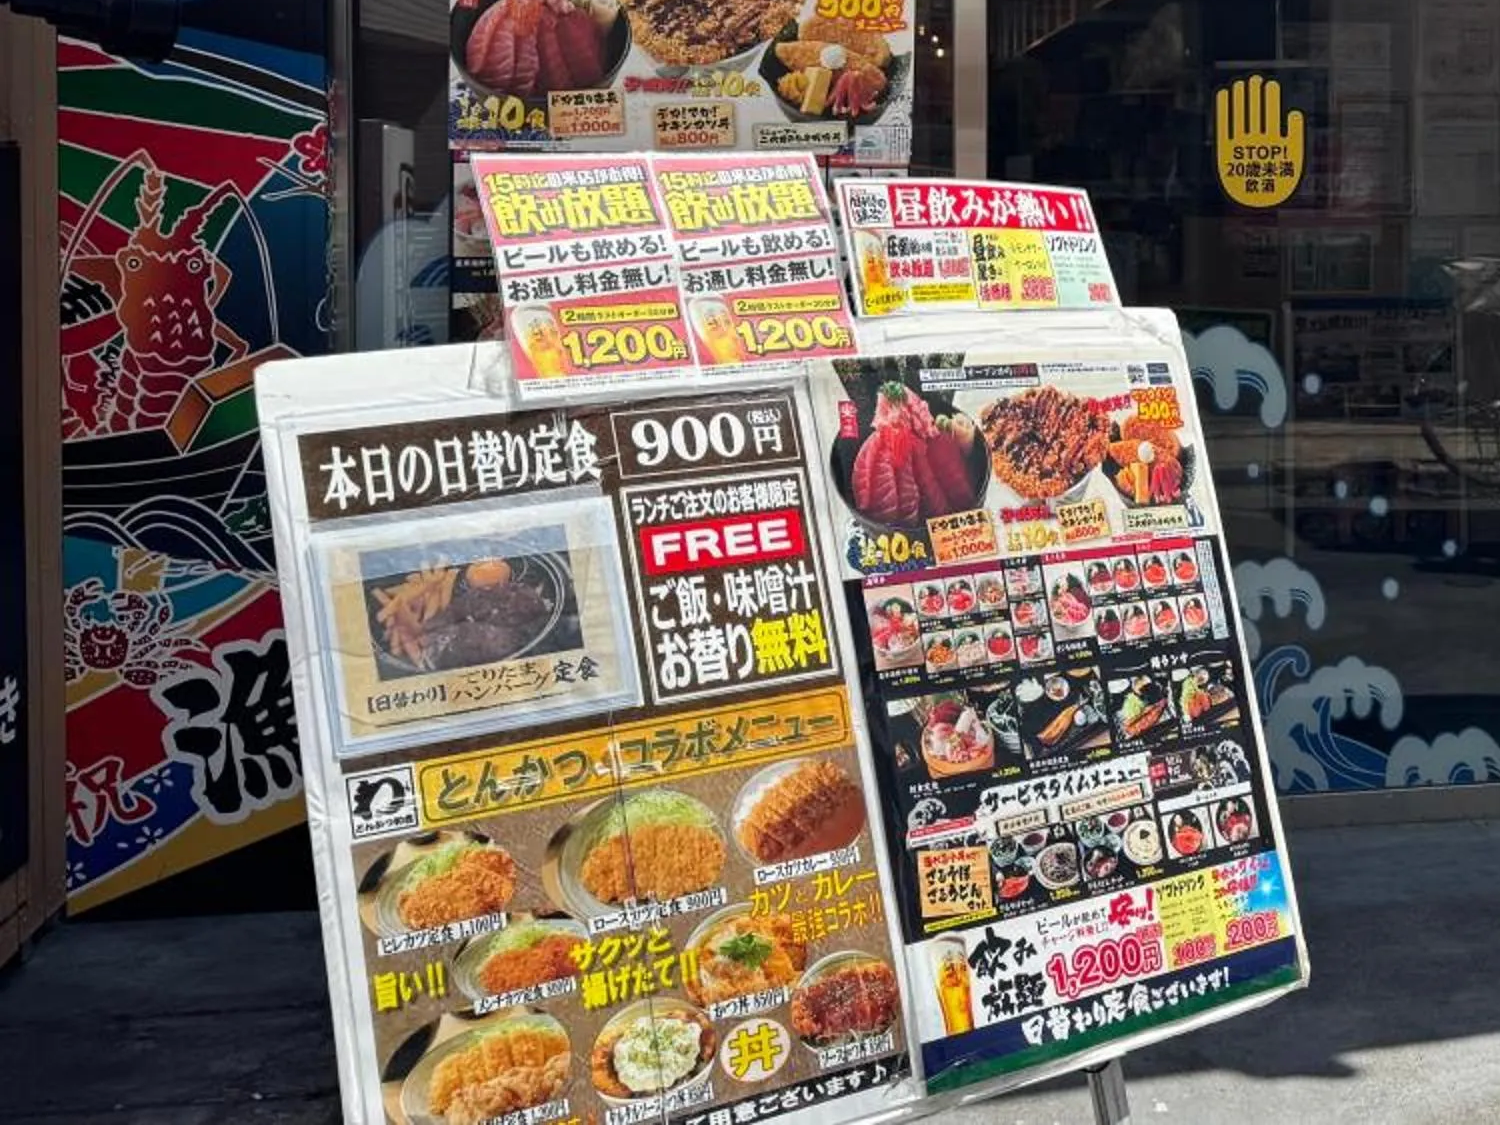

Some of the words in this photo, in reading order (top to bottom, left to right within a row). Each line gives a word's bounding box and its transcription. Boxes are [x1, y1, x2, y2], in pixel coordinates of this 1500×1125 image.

[1227, 161, 1294, 178] 20歳未満
[1233, 146, 1289, 160] STOP!
[661, 181, 822, 232] 飲み放題
[895, 186, 1092, 230] 昼飲みが熱い!!
[1245, 178, 1276, 193] 飲酒
[489, 181, 658, 237] 飲み放題
[503, 236, 666, 269] ビールも飲める!
[678, 230, 831, 264] ビールも飲める!
[507, 265, 672, 303] お通し料金無し!
[683, 258, 835, 295] お通し料金無し!
[562, 324, 689, 368] 1,200円
[735, 315, 850, 356] 1,200円
[321, 420, 600, 509] 本日の日替り定食
[631, 481, 800, 523] ランチご注文のお客様限定
[651, 518, 793, 567] FREE
[650, 560, 815, 629] ご飯・味噌汁
[552, 656, 600, 684] 定食
[657, 609, 828, 689] お替り無料
[438, 750, 590, 811] とんかつ
[619, 712, 835, 767] コラボメニュー
[983, 768, 1142, 813] サービスタイムメニュー
[750, 869, 877, 919] カツとカレー
[926, 882, 983, 906] ざるうどん
[1156, 873, 1206, 900] ソフトドリンク
[790, 892, 882, 944] 最強コラボ!!
[571, 928, 671, 971] サクッと
[967, 926, 1038, 979] 飲み
[1046, 931, 1162, 995] 1,200円
[373, 960, 446, 1012] 旨い!!
[582, 950, 700, 1011] 揚げたて!!
[981, 973, 1048, 1021] 放題
[1021, 966, 1231, 1046] 日替わり定食ございます!
[729, 1022, 782, 1078] 丼
